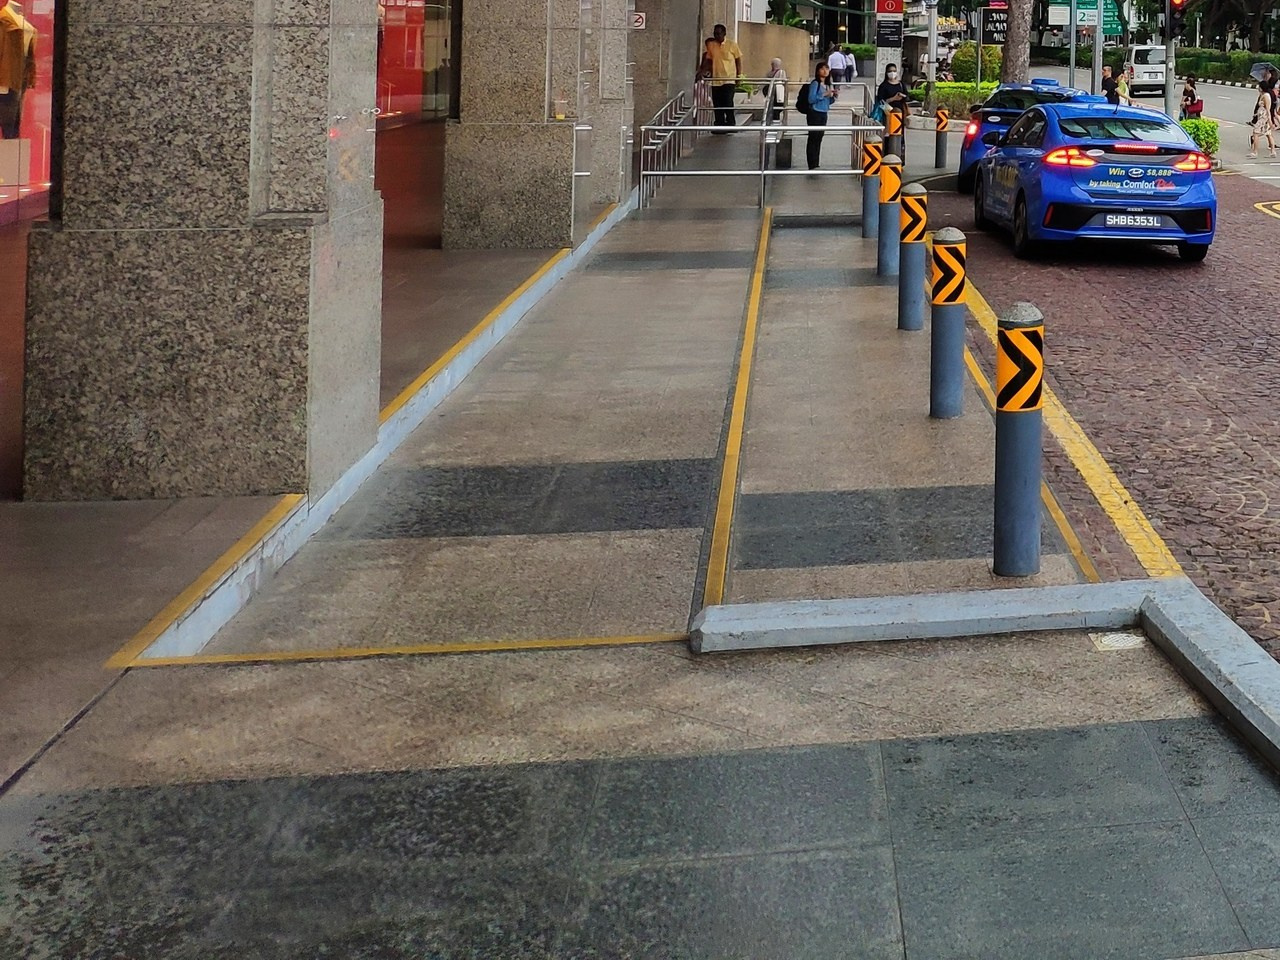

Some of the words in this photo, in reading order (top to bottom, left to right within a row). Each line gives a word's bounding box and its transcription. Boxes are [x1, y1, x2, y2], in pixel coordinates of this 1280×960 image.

[1079, 11, 1086, 22] 2
[1108, 167, 1126, 176] Win
[1088, 179, 1098, 188] by
[1099, 180, 1121, 189] taking
[1122, 179, 1156, 189] Comfort
[1106, 214, 1161, 227] SHB6353L
